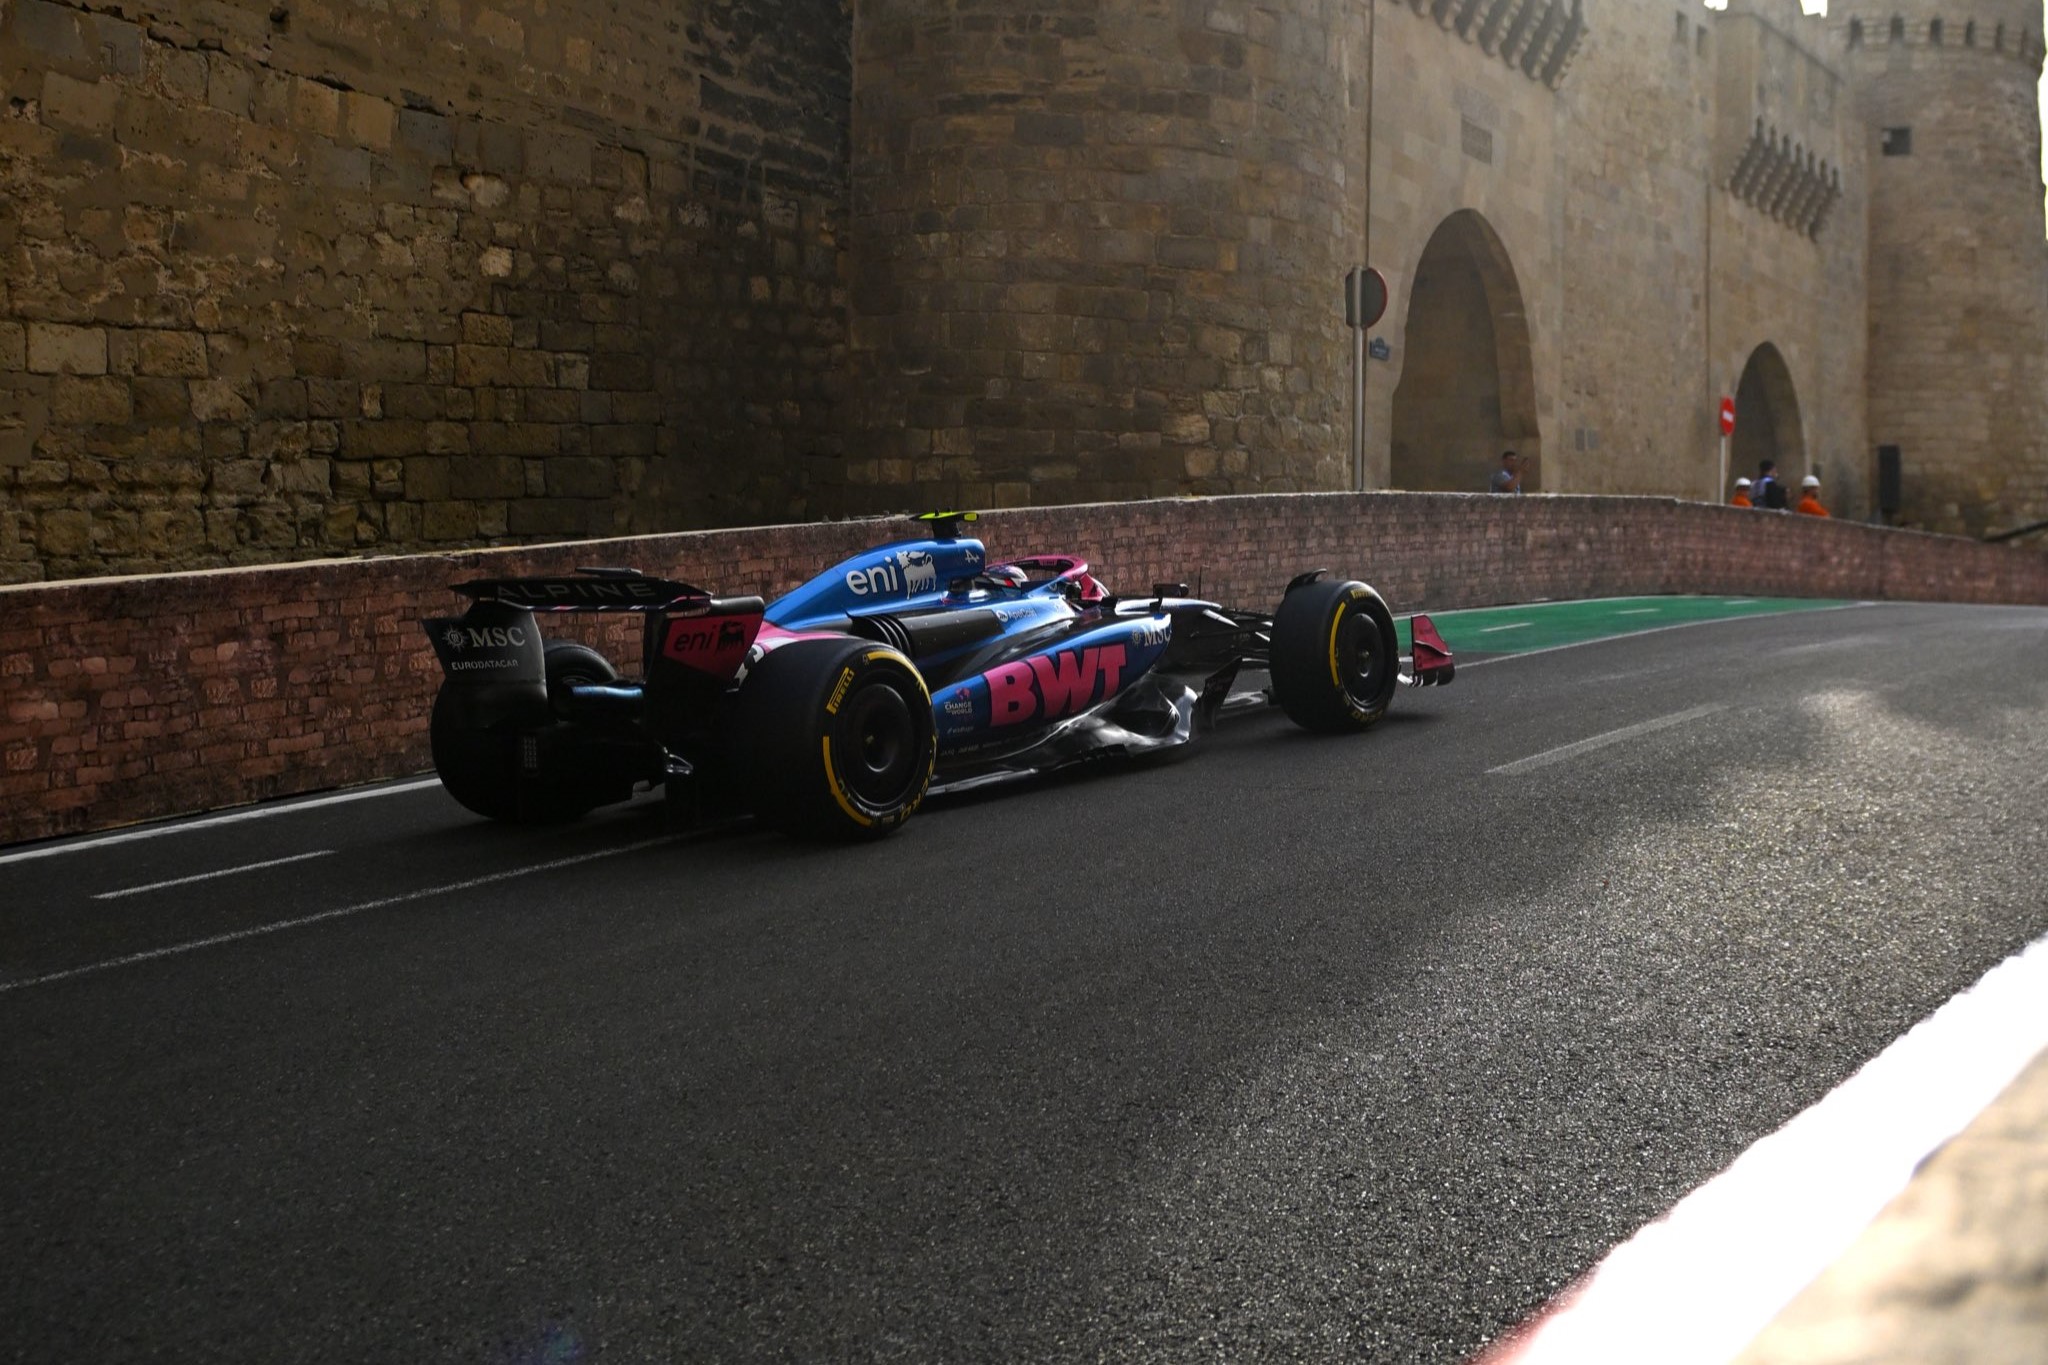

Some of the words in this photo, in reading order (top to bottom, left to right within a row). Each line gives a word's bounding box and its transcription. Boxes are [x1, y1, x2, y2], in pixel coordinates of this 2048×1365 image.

[496, 581, 655, 598] ALPINE
[846, 556, 898, 595] eni
[469, 626, 526, 648] MSC
[673, 624, 717, 652] eni
[451, 659, 518, 671] EURODATACAR
[826, 667, 855, 716] PIRELLI
[983, 643, 1126, 727] BWT
